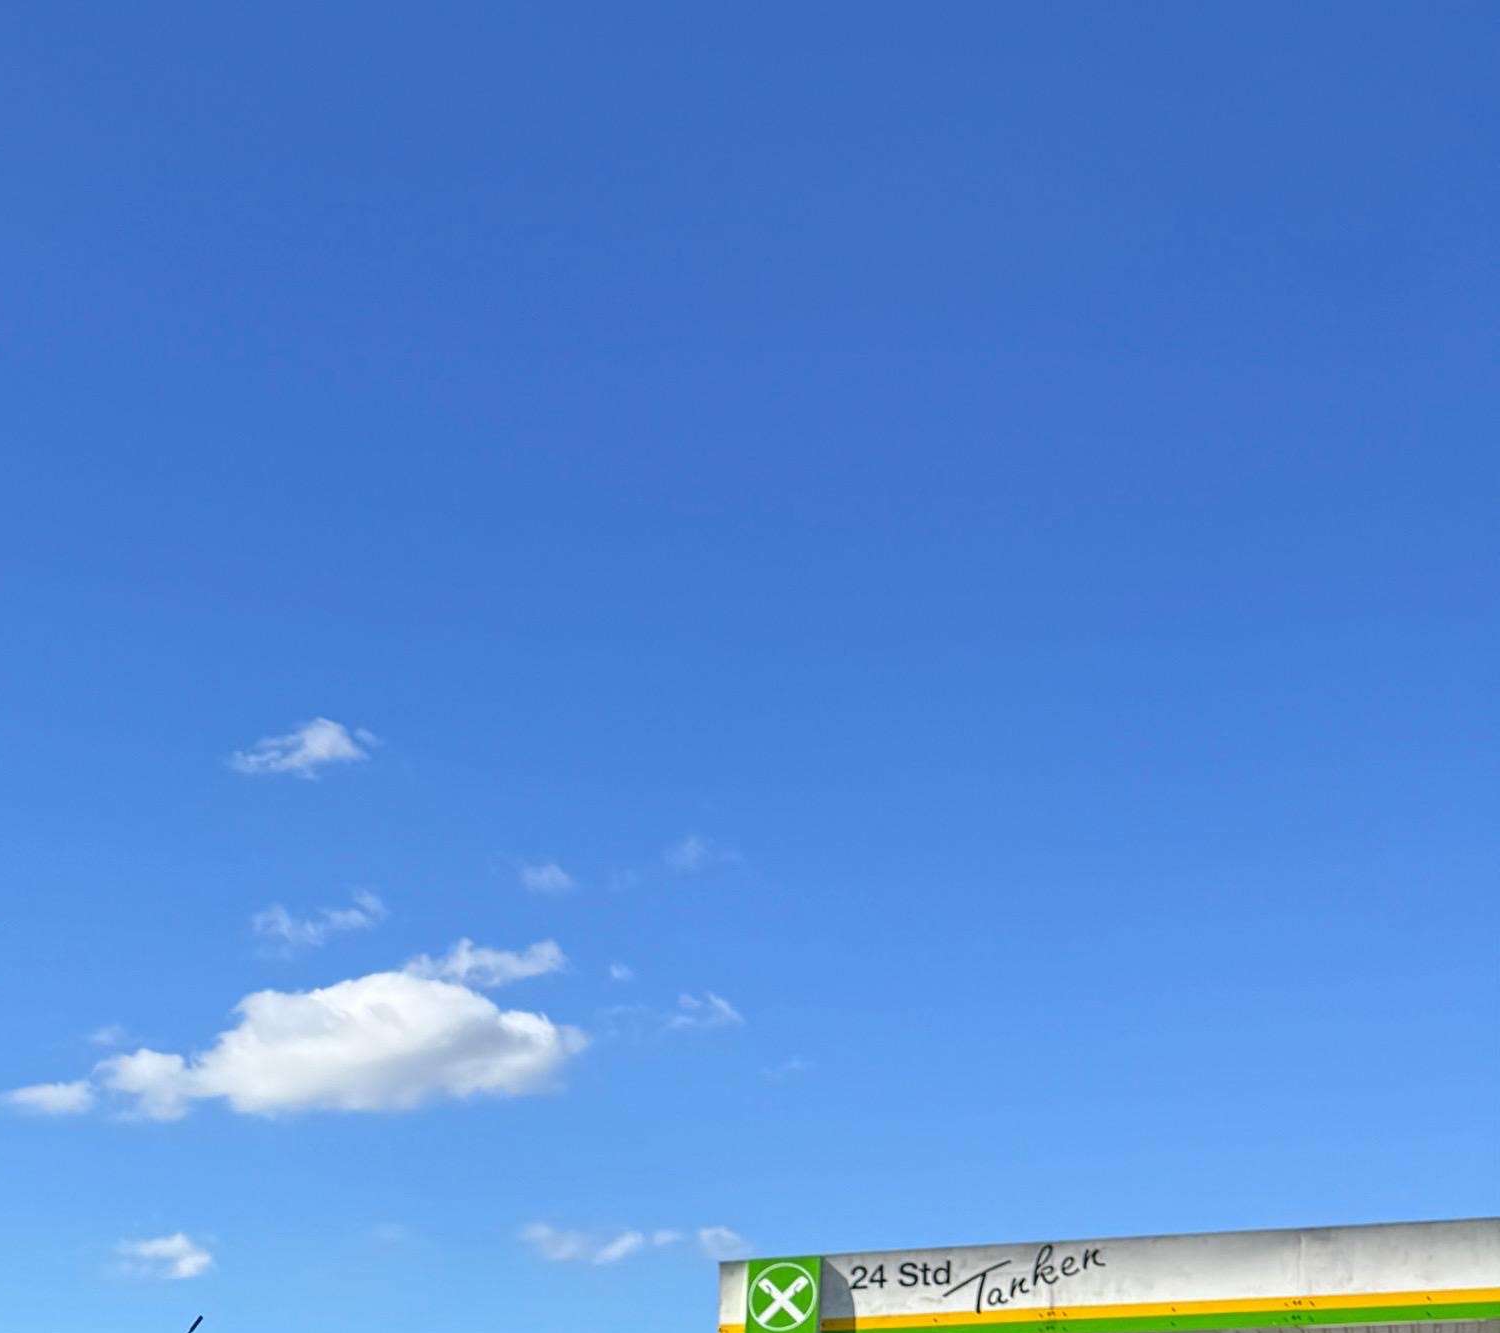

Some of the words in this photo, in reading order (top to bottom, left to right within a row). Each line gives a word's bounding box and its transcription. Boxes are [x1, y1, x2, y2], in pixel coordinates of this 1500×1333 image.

[850, 1264, 888, 1290] 24
[899, 1260, 951, 1288] Std
[942, 1244, 1107, 1314] Tanken
